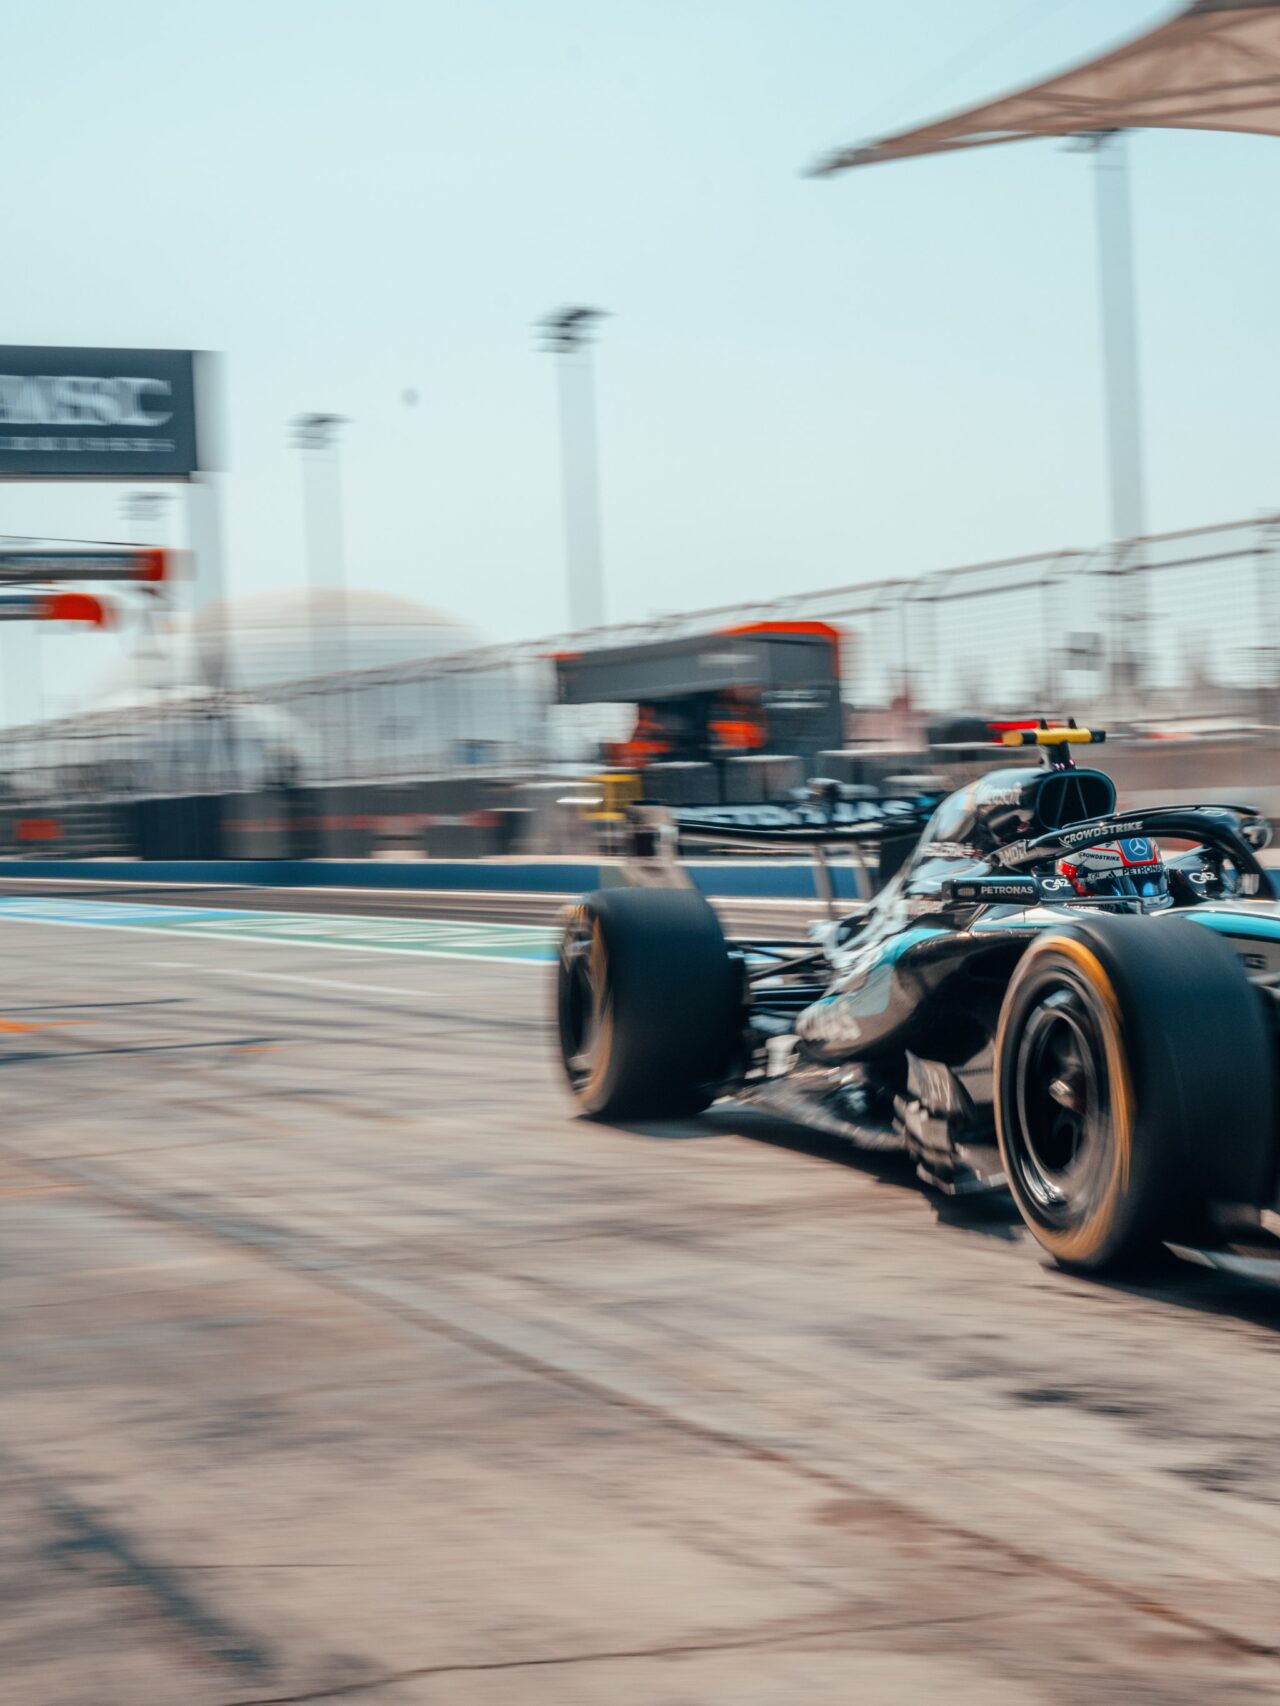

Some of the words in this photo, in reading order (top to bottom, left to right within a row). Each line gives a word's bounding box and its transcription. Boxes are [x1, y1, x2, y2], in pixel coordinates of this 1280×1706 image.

[1063, 821, 1143, 844] CROWDSTRIKE
[1079, 852, 1120, 861] CROWDSTRIKE
[981, 886, 1034, 894] PETRONAS
